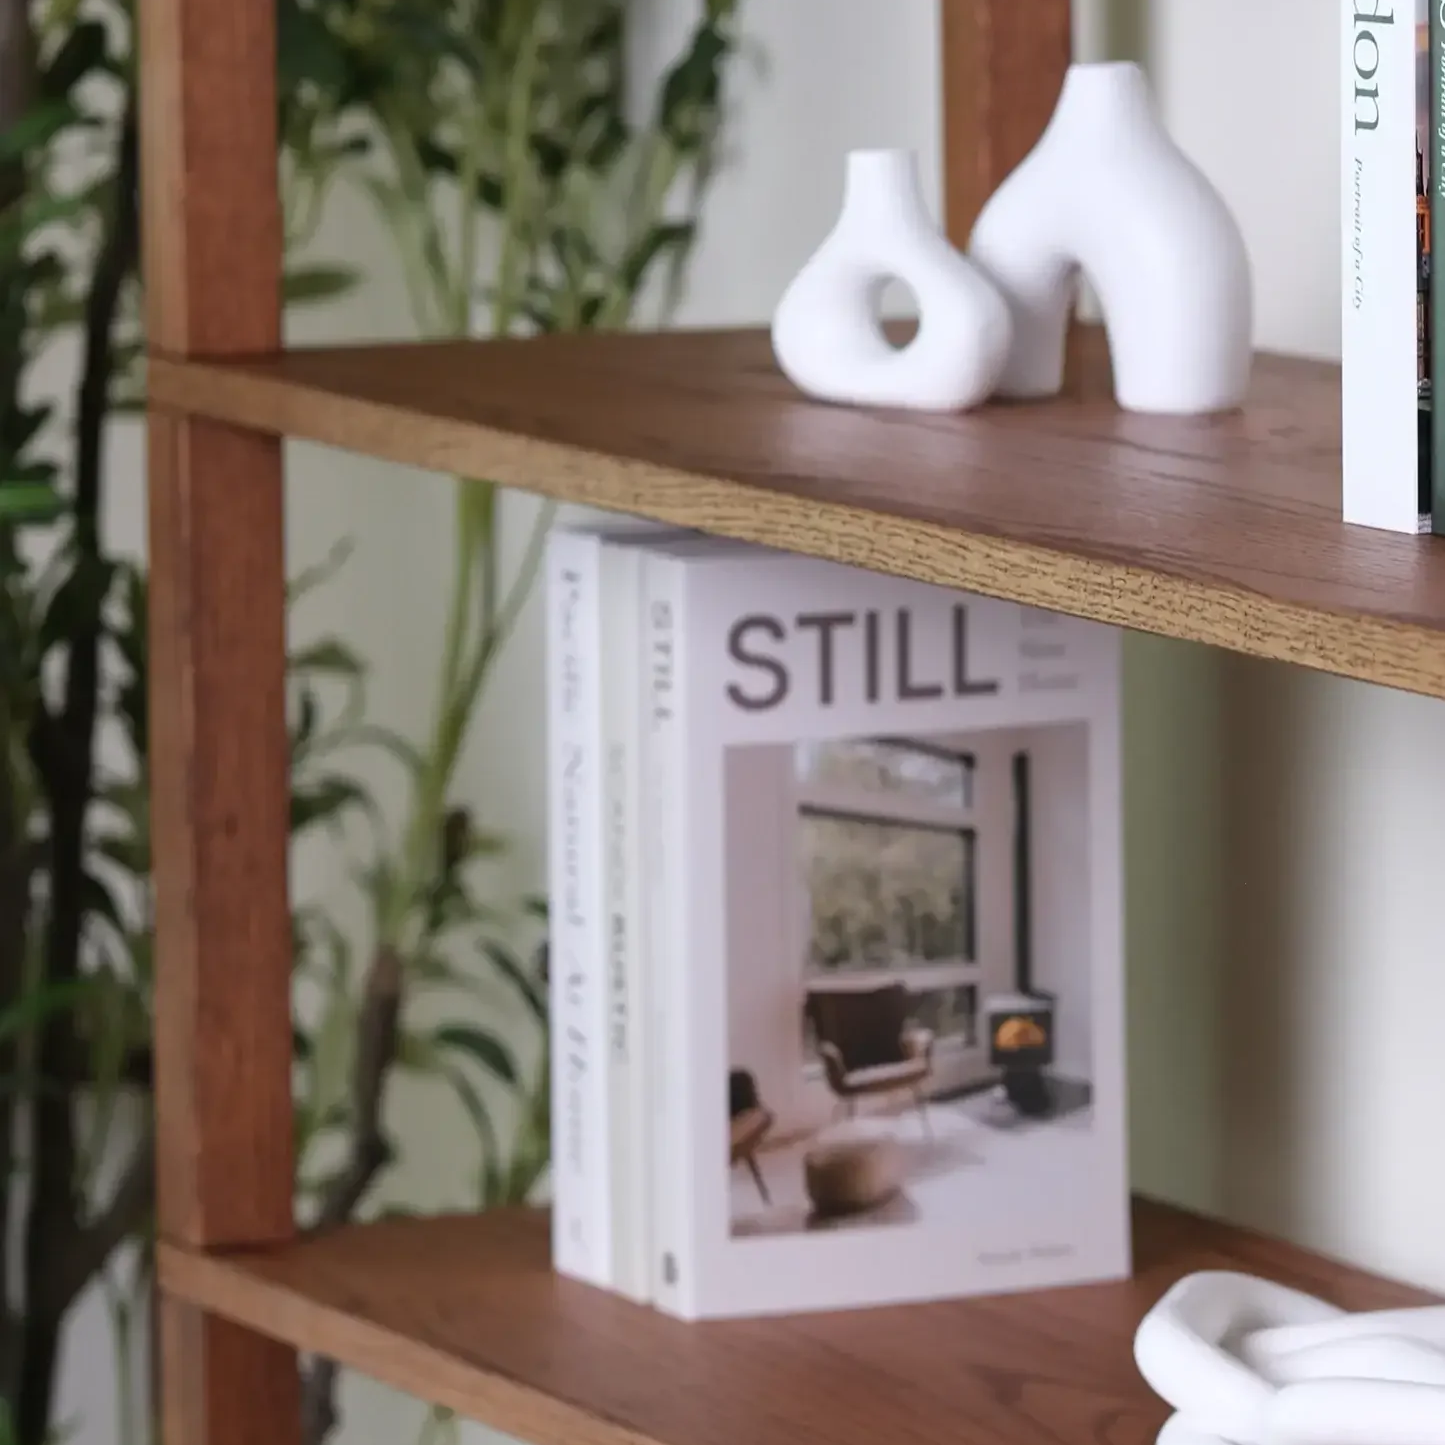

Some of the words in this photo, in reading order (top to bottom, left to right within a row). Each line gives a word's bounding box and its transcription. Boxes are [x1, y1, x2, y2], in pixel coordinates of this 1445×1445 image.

[1353, 157, 1364, 234] Portrait
[1352, 236, 1364, 260] of
[1352, 275, 1364, 310] City
[727, 603, 1000, 713] STILL
